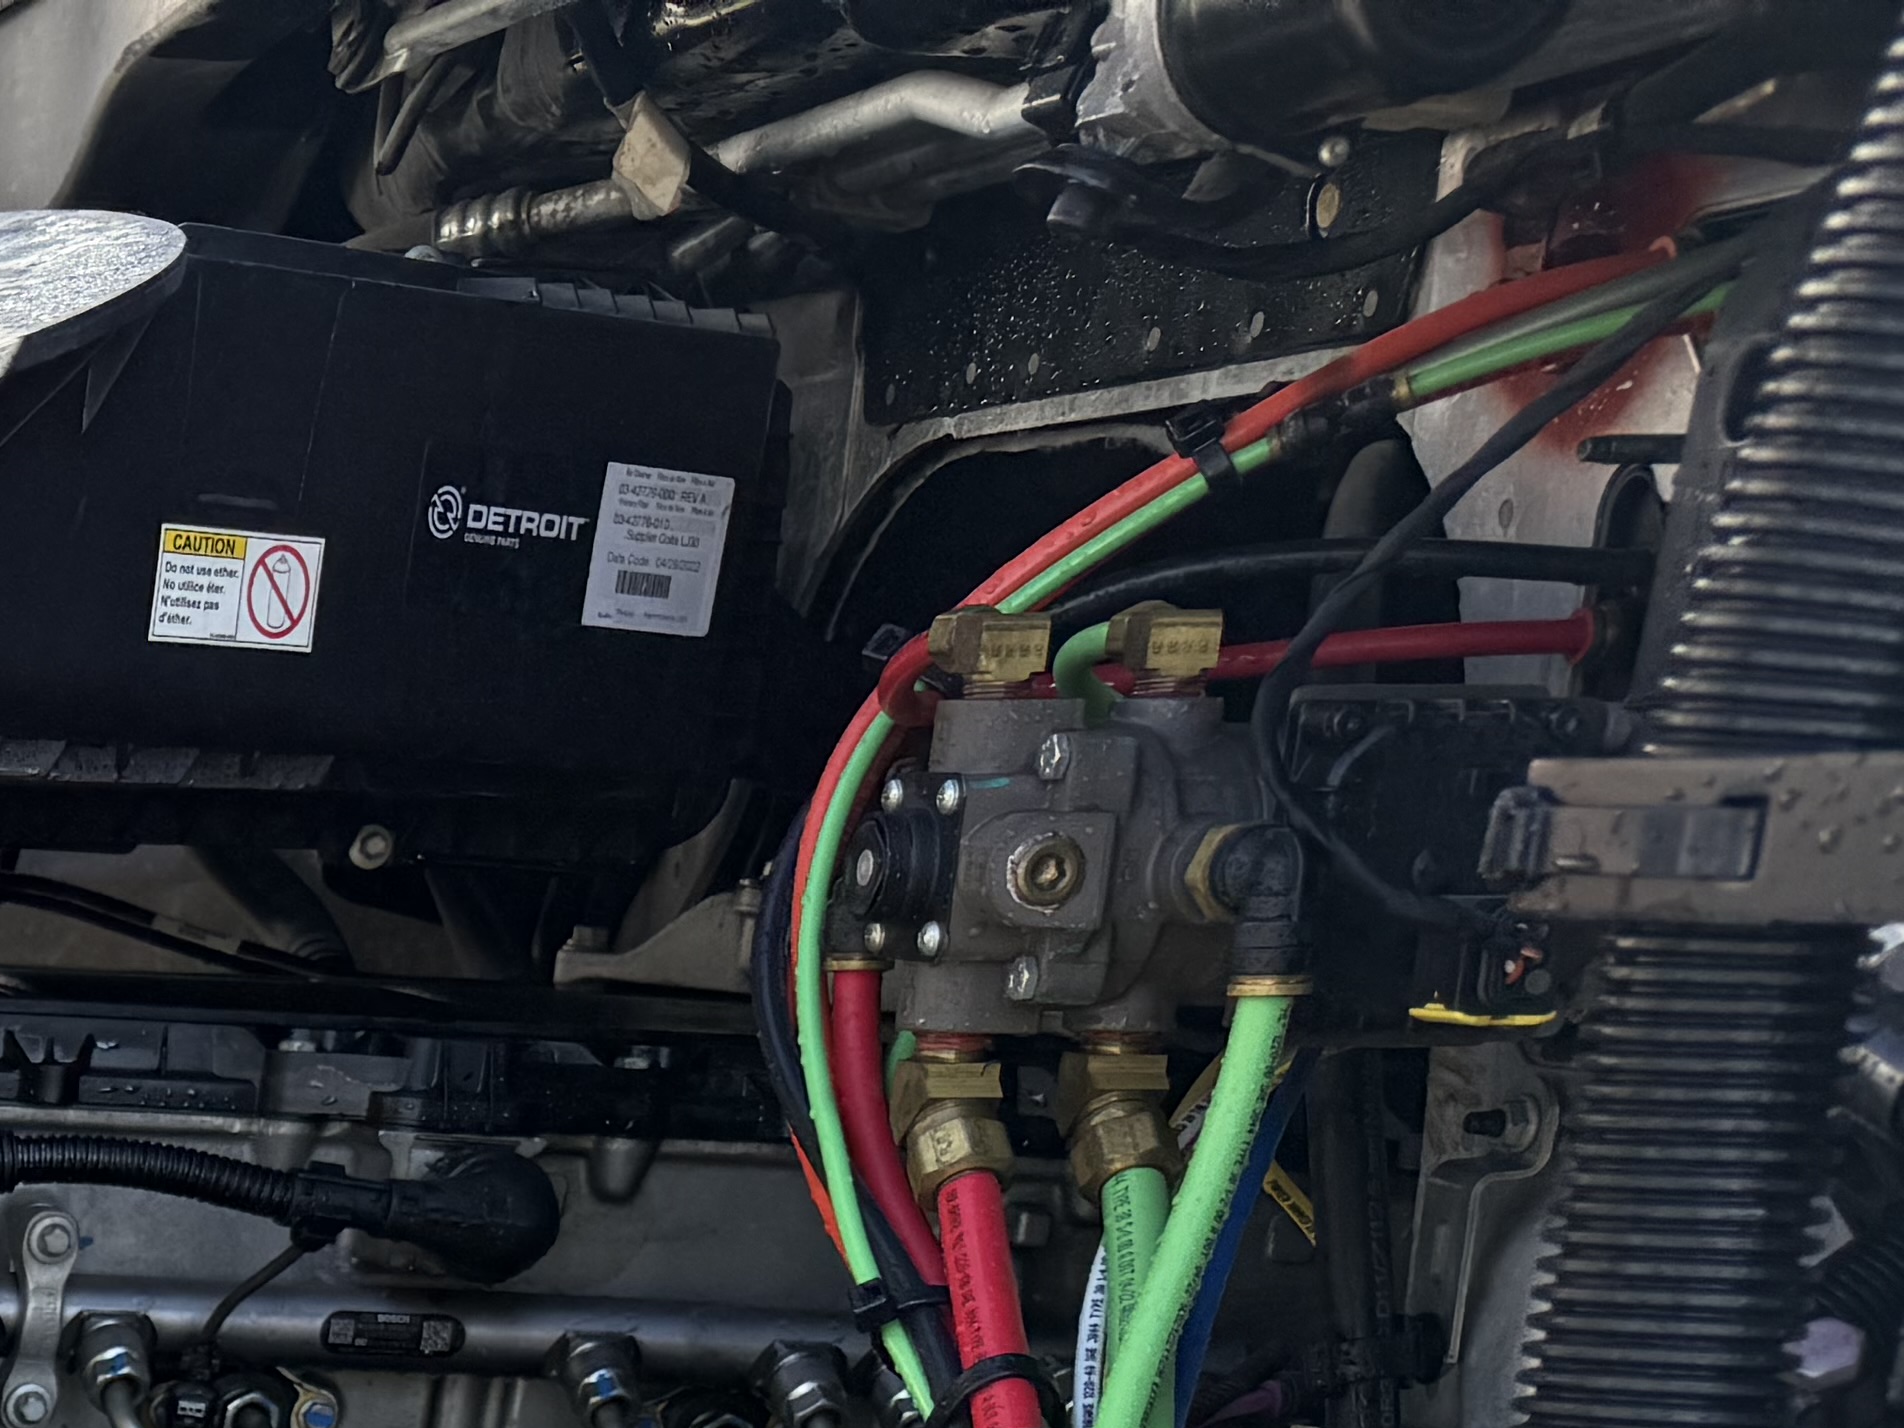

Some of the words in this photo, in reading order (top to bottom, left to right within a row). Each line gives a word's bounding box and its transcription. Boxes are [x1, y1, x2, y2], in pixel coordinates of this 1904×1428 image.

[466, 504, 585, 541] DETROIT
[173, 534, 236, 555] CAUTION
[165, 561, 177, 573] Do
[180, 564, 194, 575] not
[196, 567, 211, 576] use
[163, 579, 175, 590] No
[203, 600, 219, 612] pas
